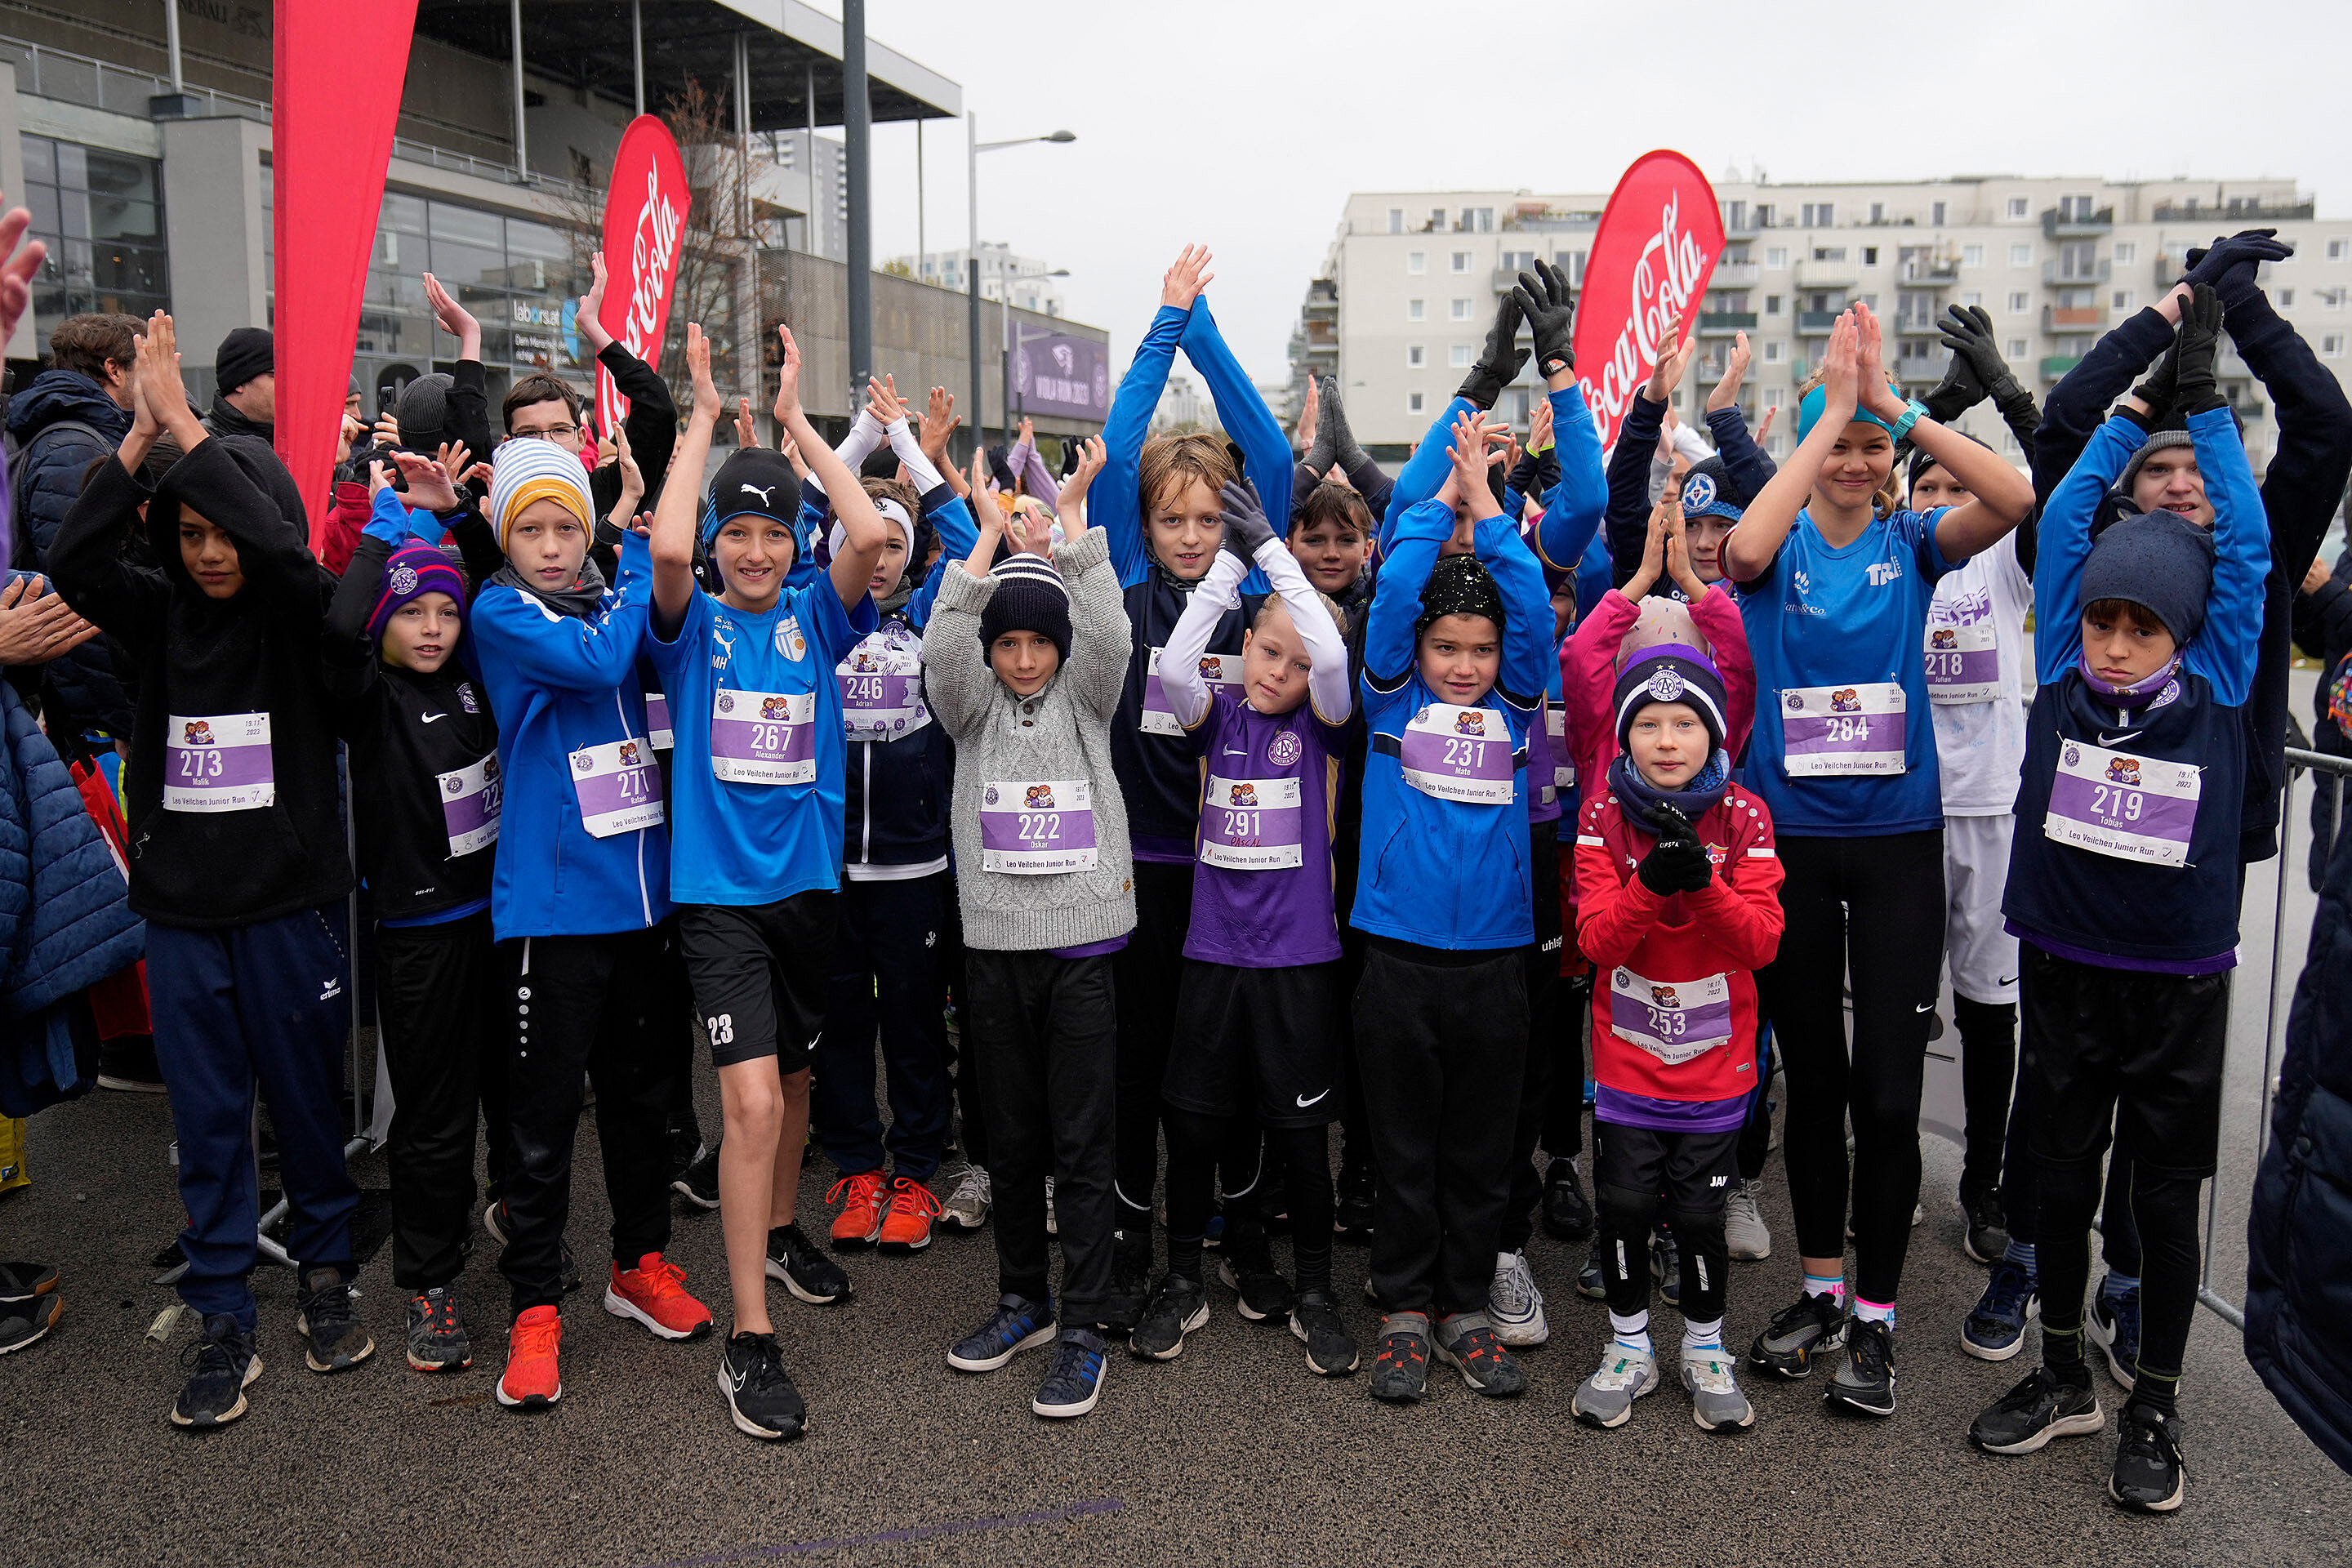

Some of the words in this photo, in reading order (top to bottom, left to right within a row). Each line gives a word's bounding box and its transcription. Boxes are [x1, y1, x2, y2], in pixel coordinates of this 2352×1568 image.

[711, 654, 728, 670] MH
[1925, 653, 1962, 675] 218
[846, 677, 883, 700] 246
[1168, 722, 1179, 730] Leo
[1826, 716, 1869, 742] 284
[750, 724, 793, 751] 267
[755, 751, 785, 760] Alexander
[1442, 738, 1485, 768] 231
[180, 750, 223, 777] 273
[1824, 761, 1853, 769] Veilchen
[1853, 761, 1873, 769] Junior
[733, 768, 745, 776] Leo
[746, 768, 773, 778] Veilchen
[774, 770, 792, 779] Junior
[1454, 767, 1472, 776] Mate
[192, 777, 209, 786] Malik
[617, 768, 649, 798] 271
[2176, 781, 2192, 789] 2023
[1425, 782, 1436, 791] Leo
[1437, 784, 1465, 795] Veilchen
[1466, 788, 1485, 797] Junior
[208, 797, 229, 806] Junior
[232, 796, 246, 804] Run
[630, 795, 647, 804] Rafael
[2090, 785, 2144, 822] 219
[612, 819, 623, 828] Leo
[624, 813, 647, 826] Veilchen
[1018, 813, 1061, 840] 222
[1224, 810, 1261, 836] 291
[2100, 815, 2123, 828] Tobias
[477, 835, 487, 844] Leo
[1230, 836, 1262, 848] PASCAL
[2069, 830, 2081, 840] Leo
[2082, 833, 2113, 848] Veilchen
[2114, 841, 2137, 853] Junior
[2139, 844, 2155, 856] Run
[1006, 860, 1017, 868] Leo
[1018, 860, 1045, 868] Veilchen
[1045, 860, 1064, 868] Junior
[1214, 853, 1223, 861] Leo
[1223, 854, 1247, 864] Veilchen
[1248, 856, 1268, 864] Junior
[1268, 855, 1281, 863] Run
[1542, 934, 1563, 951] uhlsp
[319, 987, 341, 1000] erima
[1707, 987, 1721, 996] 2023
[1646, 1006, 1686, 1036] 253
[707, 1013, 733, 1046] 23
[1637, 1040, 1648, 1049] Leo
[1673, 1050, 1692, 1060] Junior
[1693, 1048, 1707, 1056] Run
